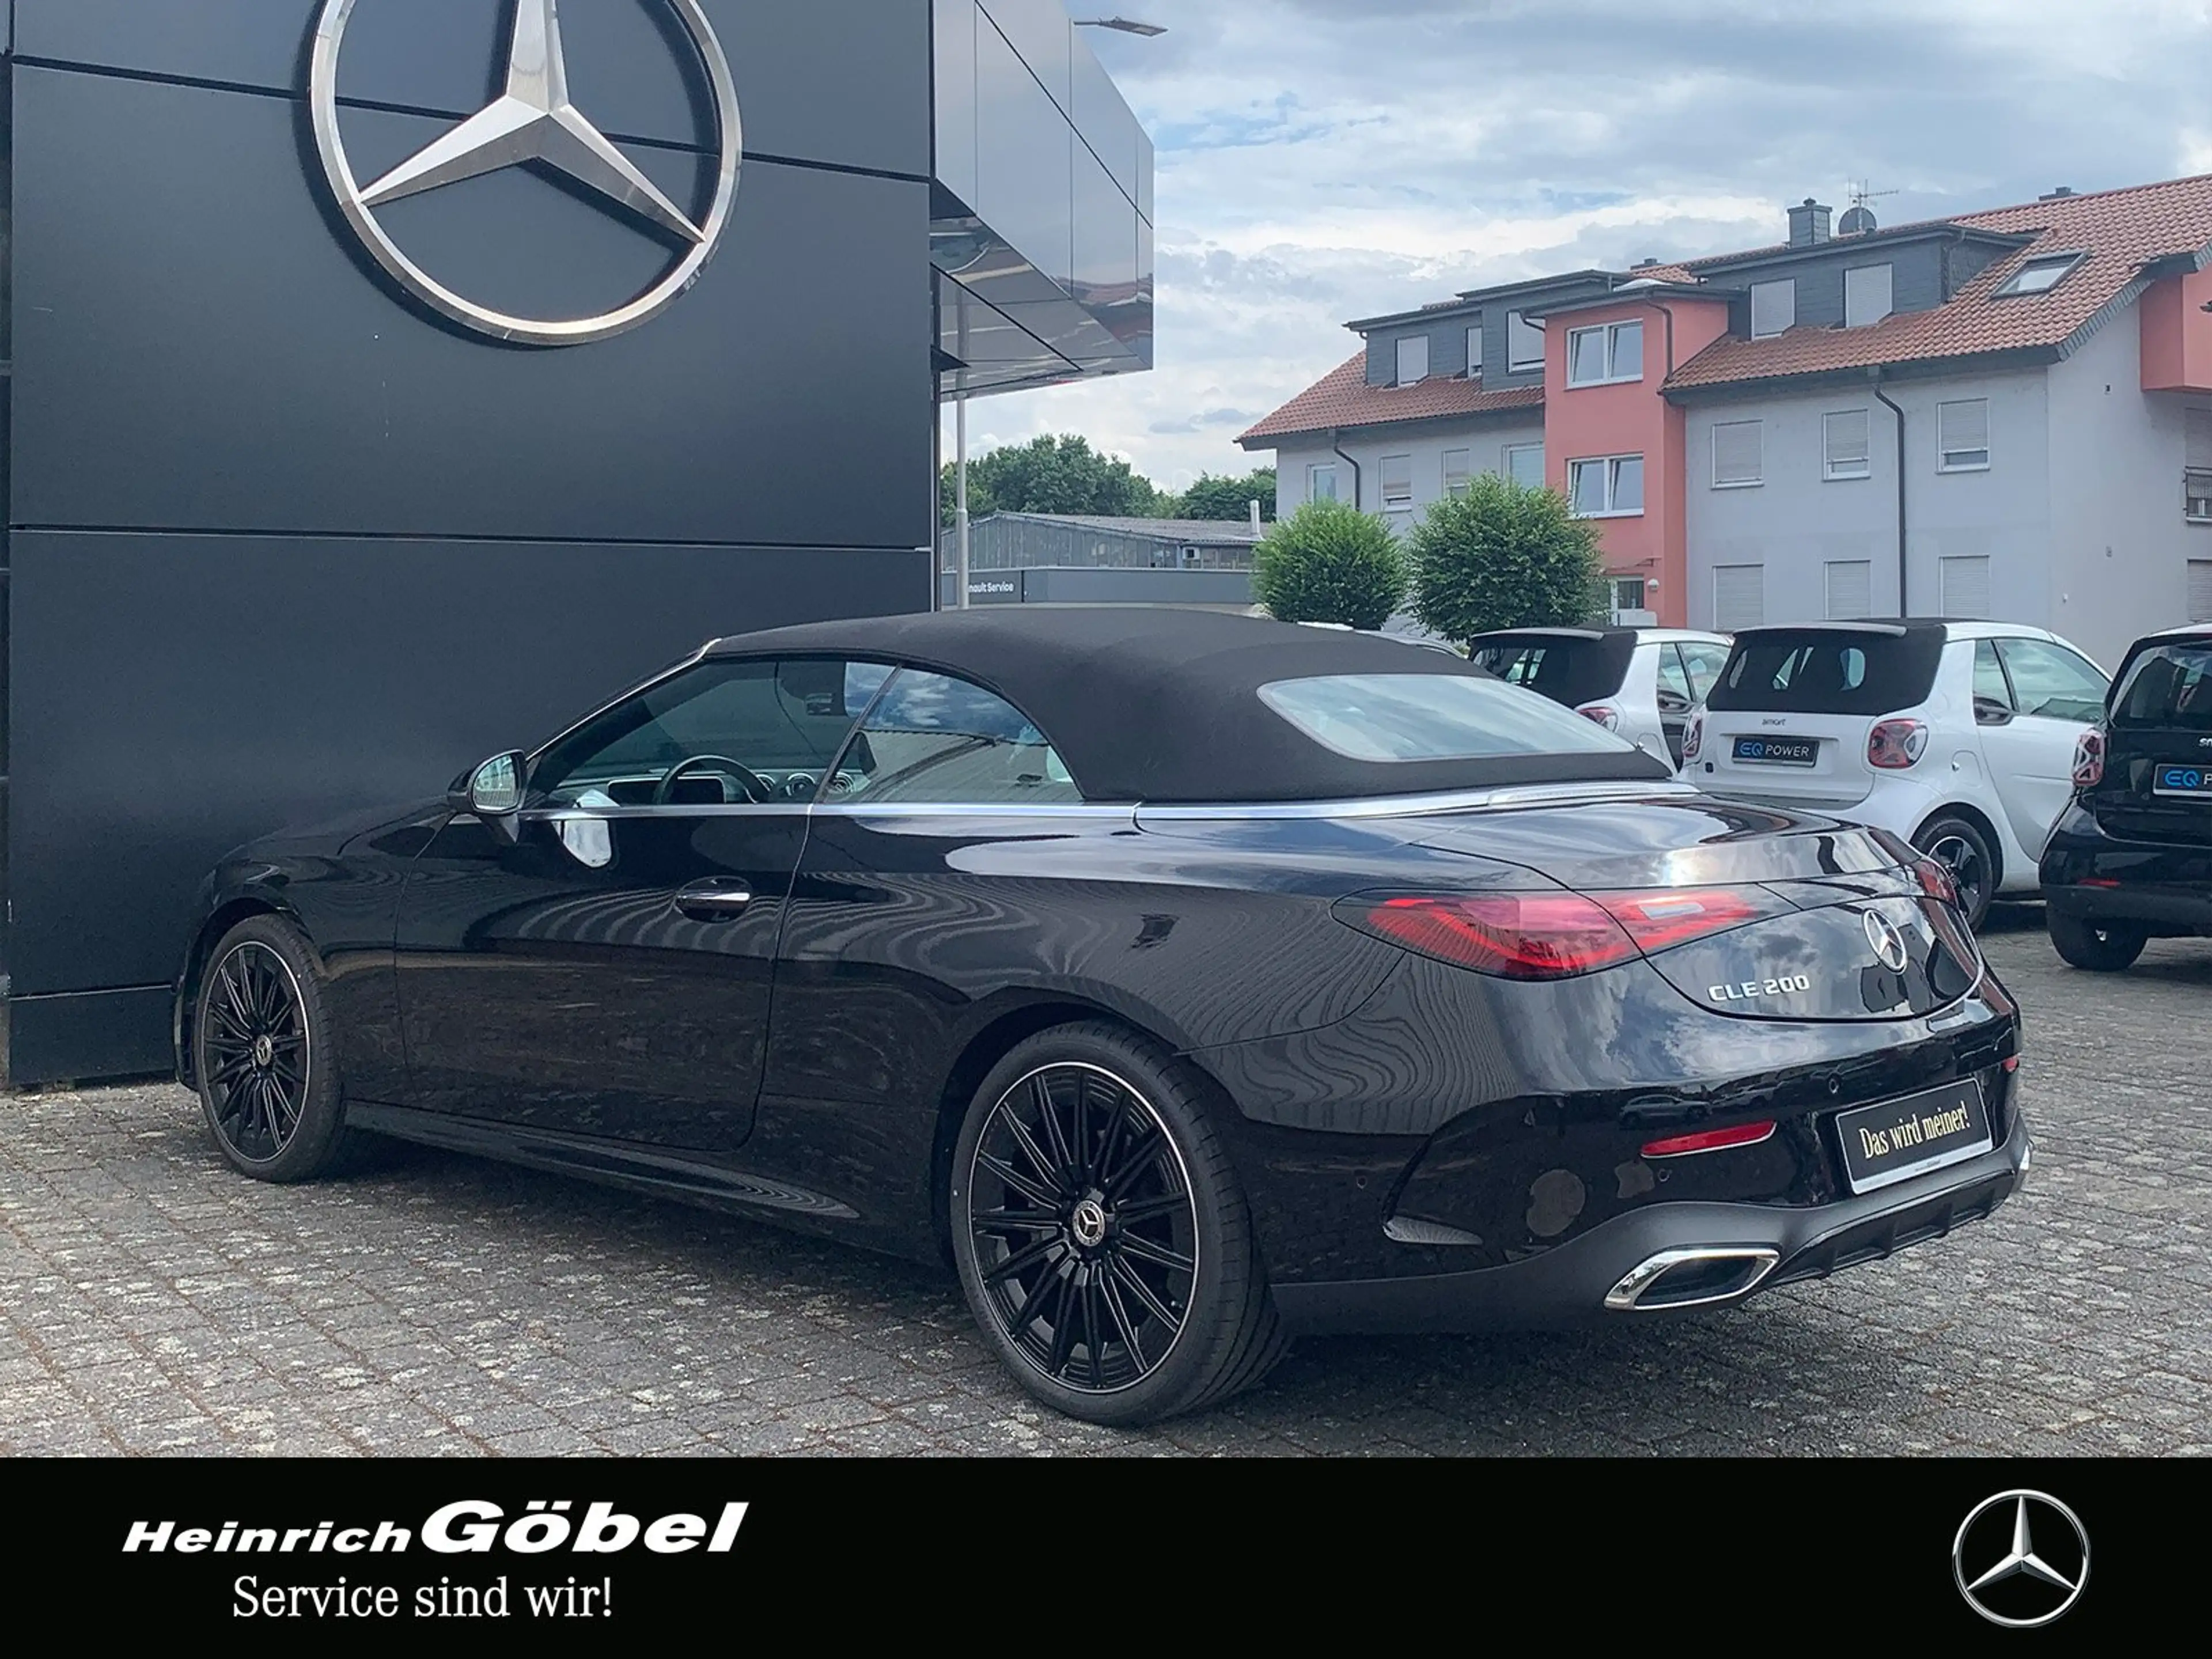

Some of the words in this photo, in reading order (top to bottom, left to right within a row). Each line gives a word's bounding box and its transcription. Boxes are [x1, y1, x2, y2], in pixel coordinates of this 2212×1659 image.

[987, 581, 1014, 593] Service
[1740, 742, 1763, 756] EQ
[1765, 744, 1810, 757] POWER
[2165, 770, 2200, 787] EQ
[1707, 982, 1760, 1002] CLE
[1762, 975, 1810, 996] 200
[1859, 1127, 1889, 1160] Das
[1889, 1113, 1923, 1150] wird
[1922, 1100, 1971, 1141] meiner!
